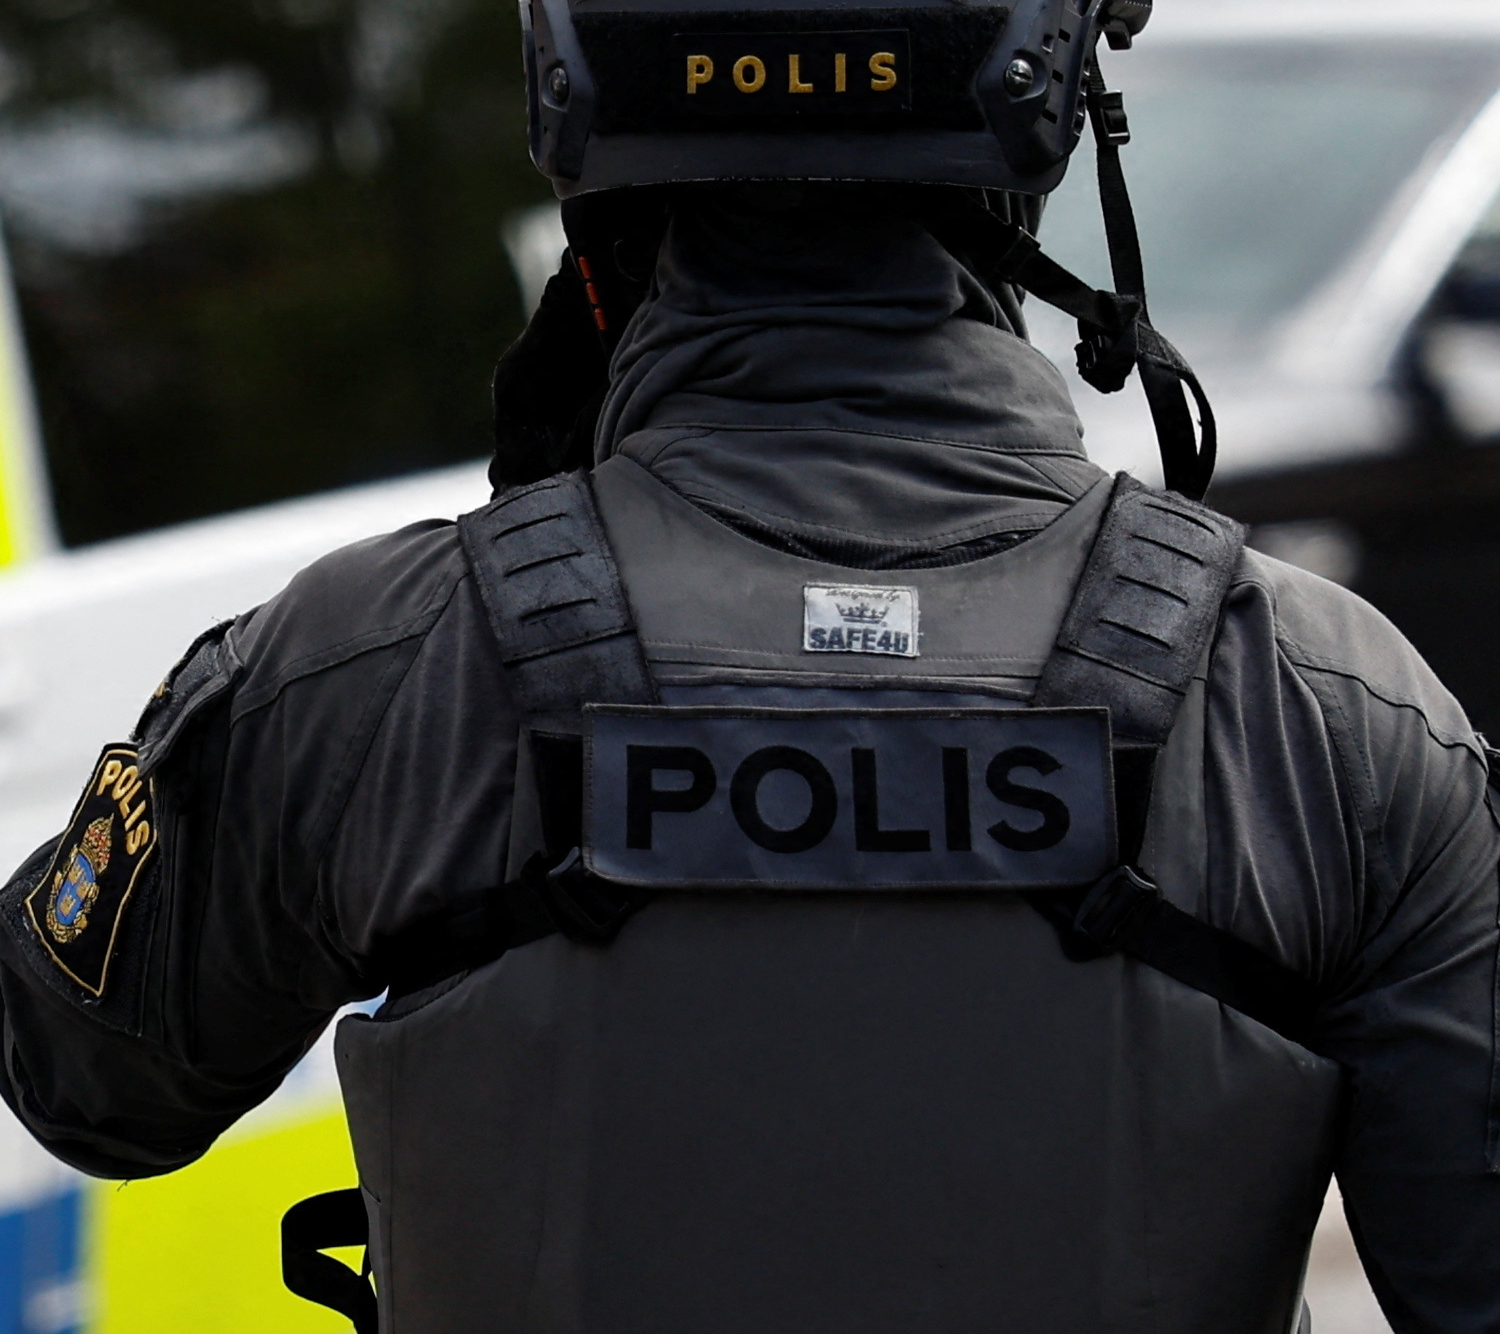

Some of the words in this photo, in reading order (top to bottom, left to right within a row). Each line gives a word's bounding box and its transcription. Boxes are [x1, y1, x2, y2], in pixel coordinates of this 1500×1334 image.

[686, 51, 898, 95] POLIS
[809, 626, 910, 654] SAFE4U
[96, 759, 150, 856] POLIS
[625, 743, 1072, 854] POLIS
